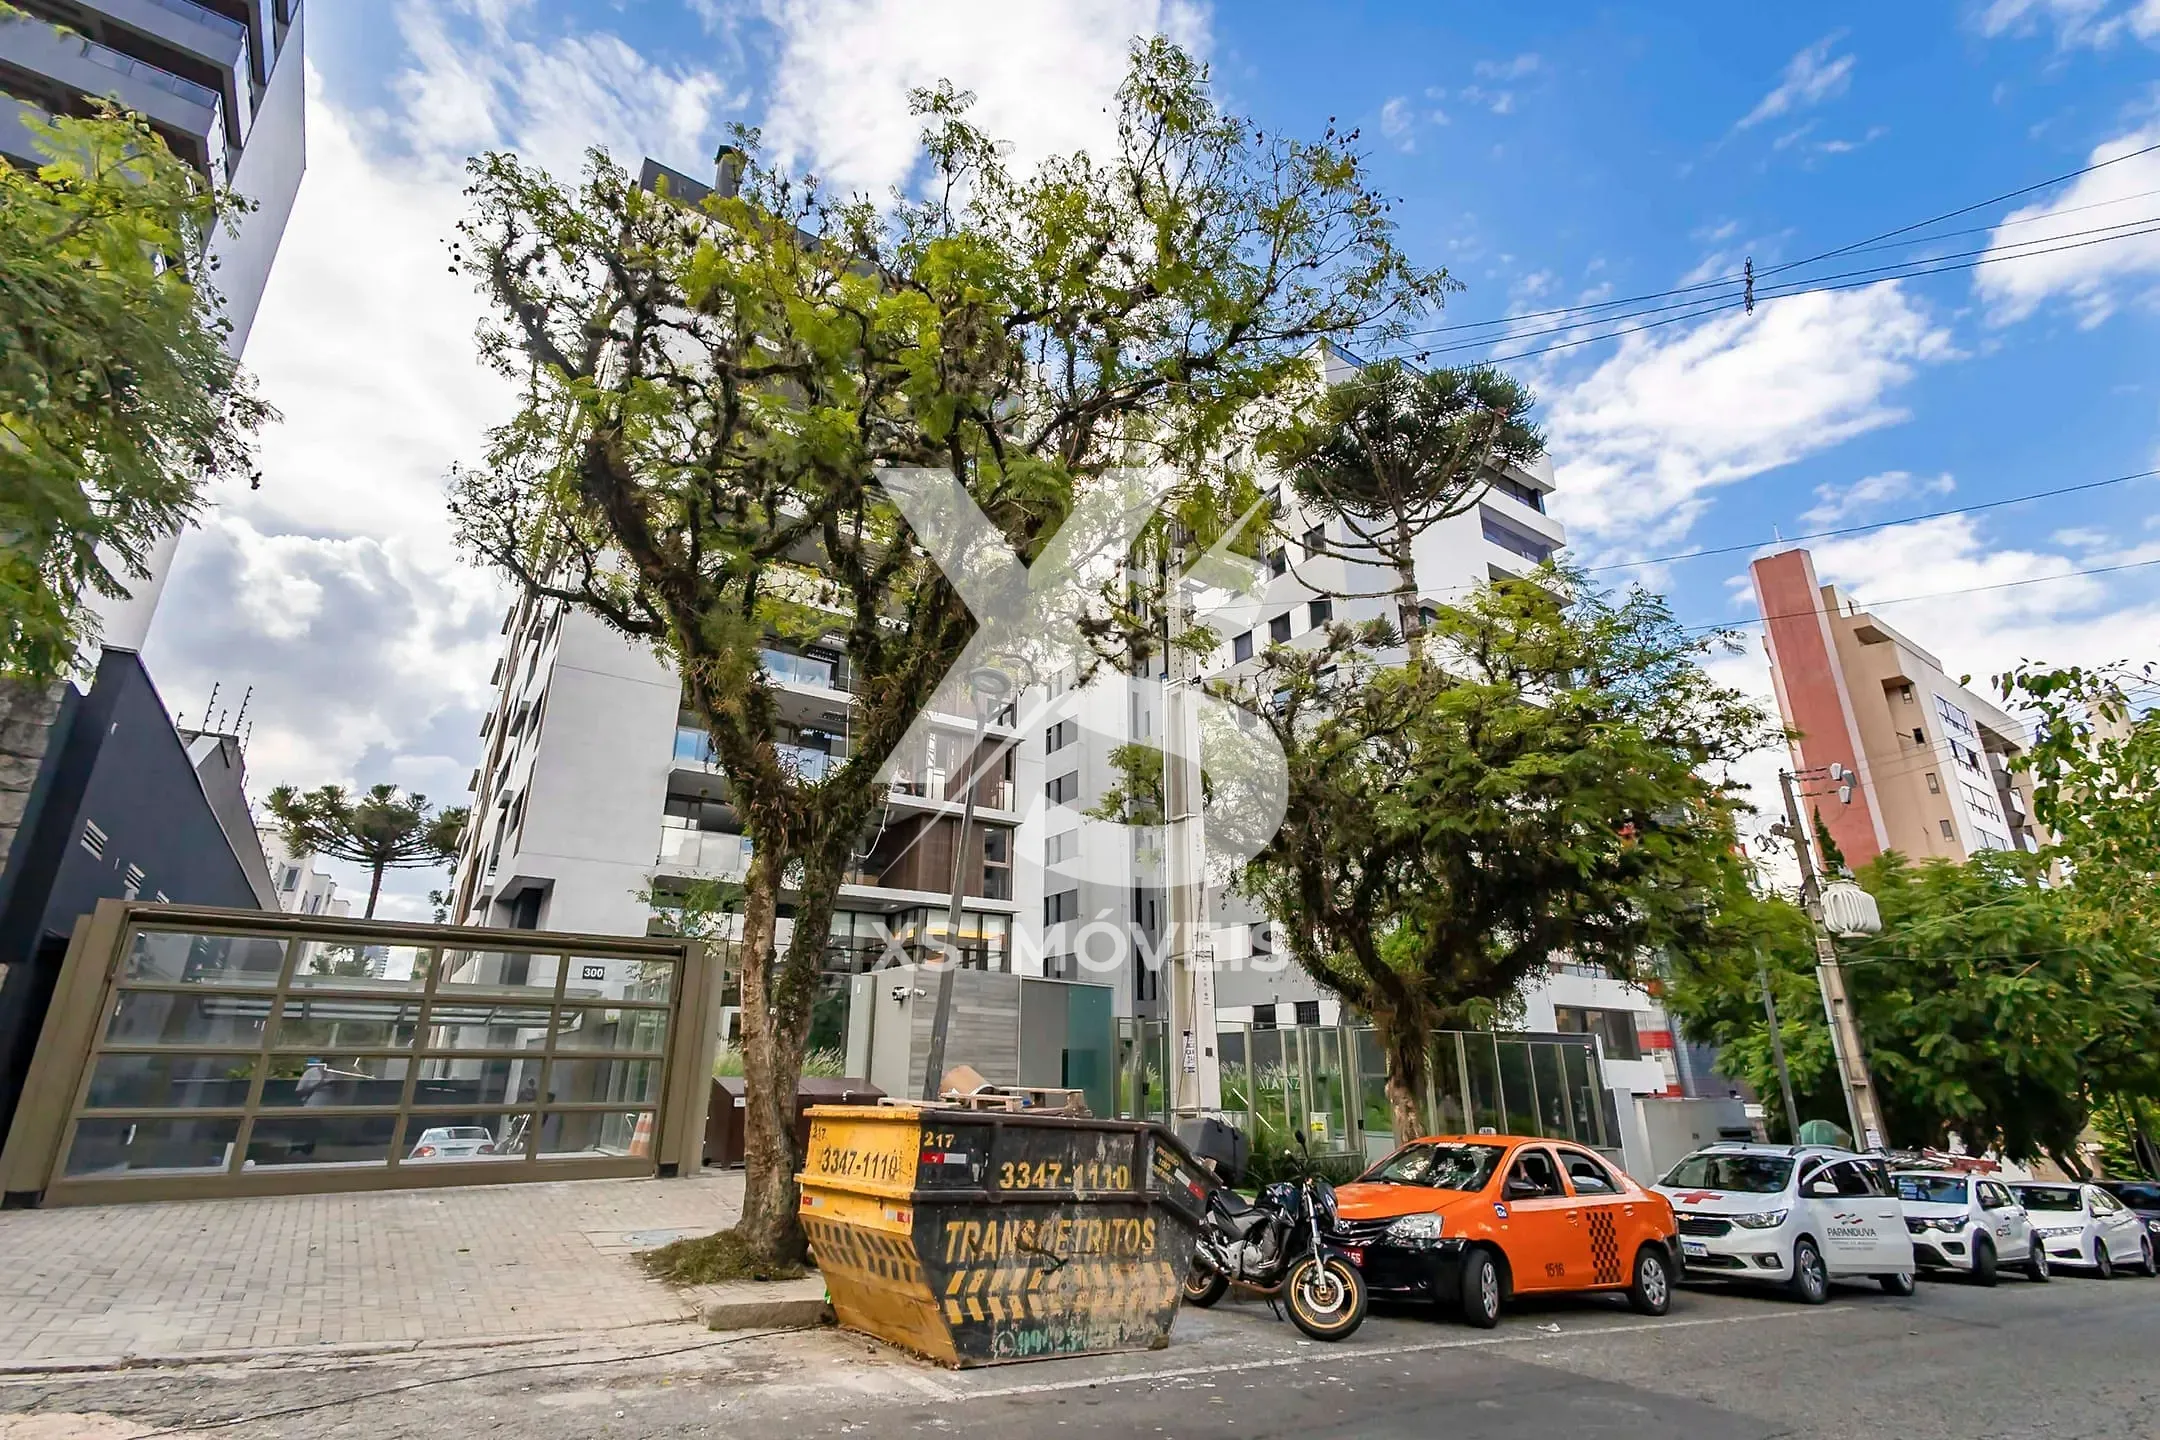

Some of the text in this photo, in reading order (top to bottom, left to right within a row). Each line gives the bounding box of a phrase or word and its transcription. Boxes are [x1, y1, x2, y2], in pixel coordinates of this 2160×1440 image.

[584, 967, 604, 978] 300
[923, 1131, 955, 1148] 217
[821, 1147, 899, 1180] 3347-1110
[999, 1160, 1129, 1191] 3347-1110
[1827, 1227, 1877, 1237] PAPANDUVA
